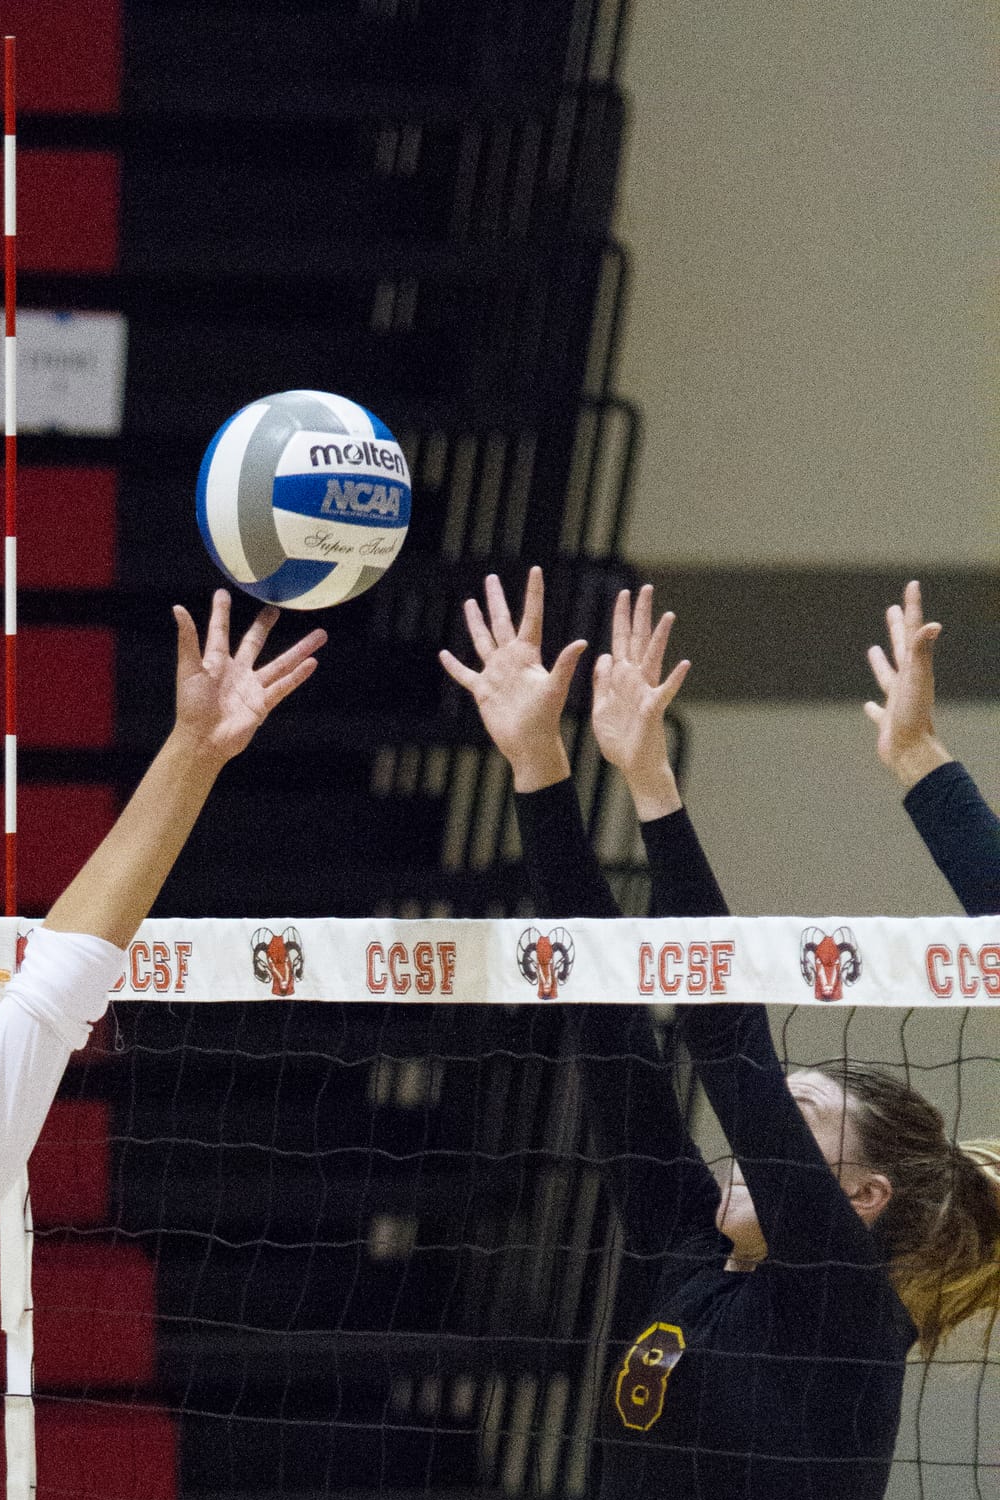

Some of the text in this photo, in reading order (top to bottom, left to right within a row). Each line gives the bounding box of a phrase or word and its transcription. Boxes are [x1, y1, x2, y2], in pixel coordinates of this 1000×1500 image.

[310, 442, 405, 476] molten
[321, 479, 403, 517] NCAA
[304, 529, 354, 556] Super
[108, 941, 193, 992] CSF
[366, 941, 457, 994] CCSF
[638, 941, 735, 995] CCSF
[616, 1322, 686, 1431] 8
